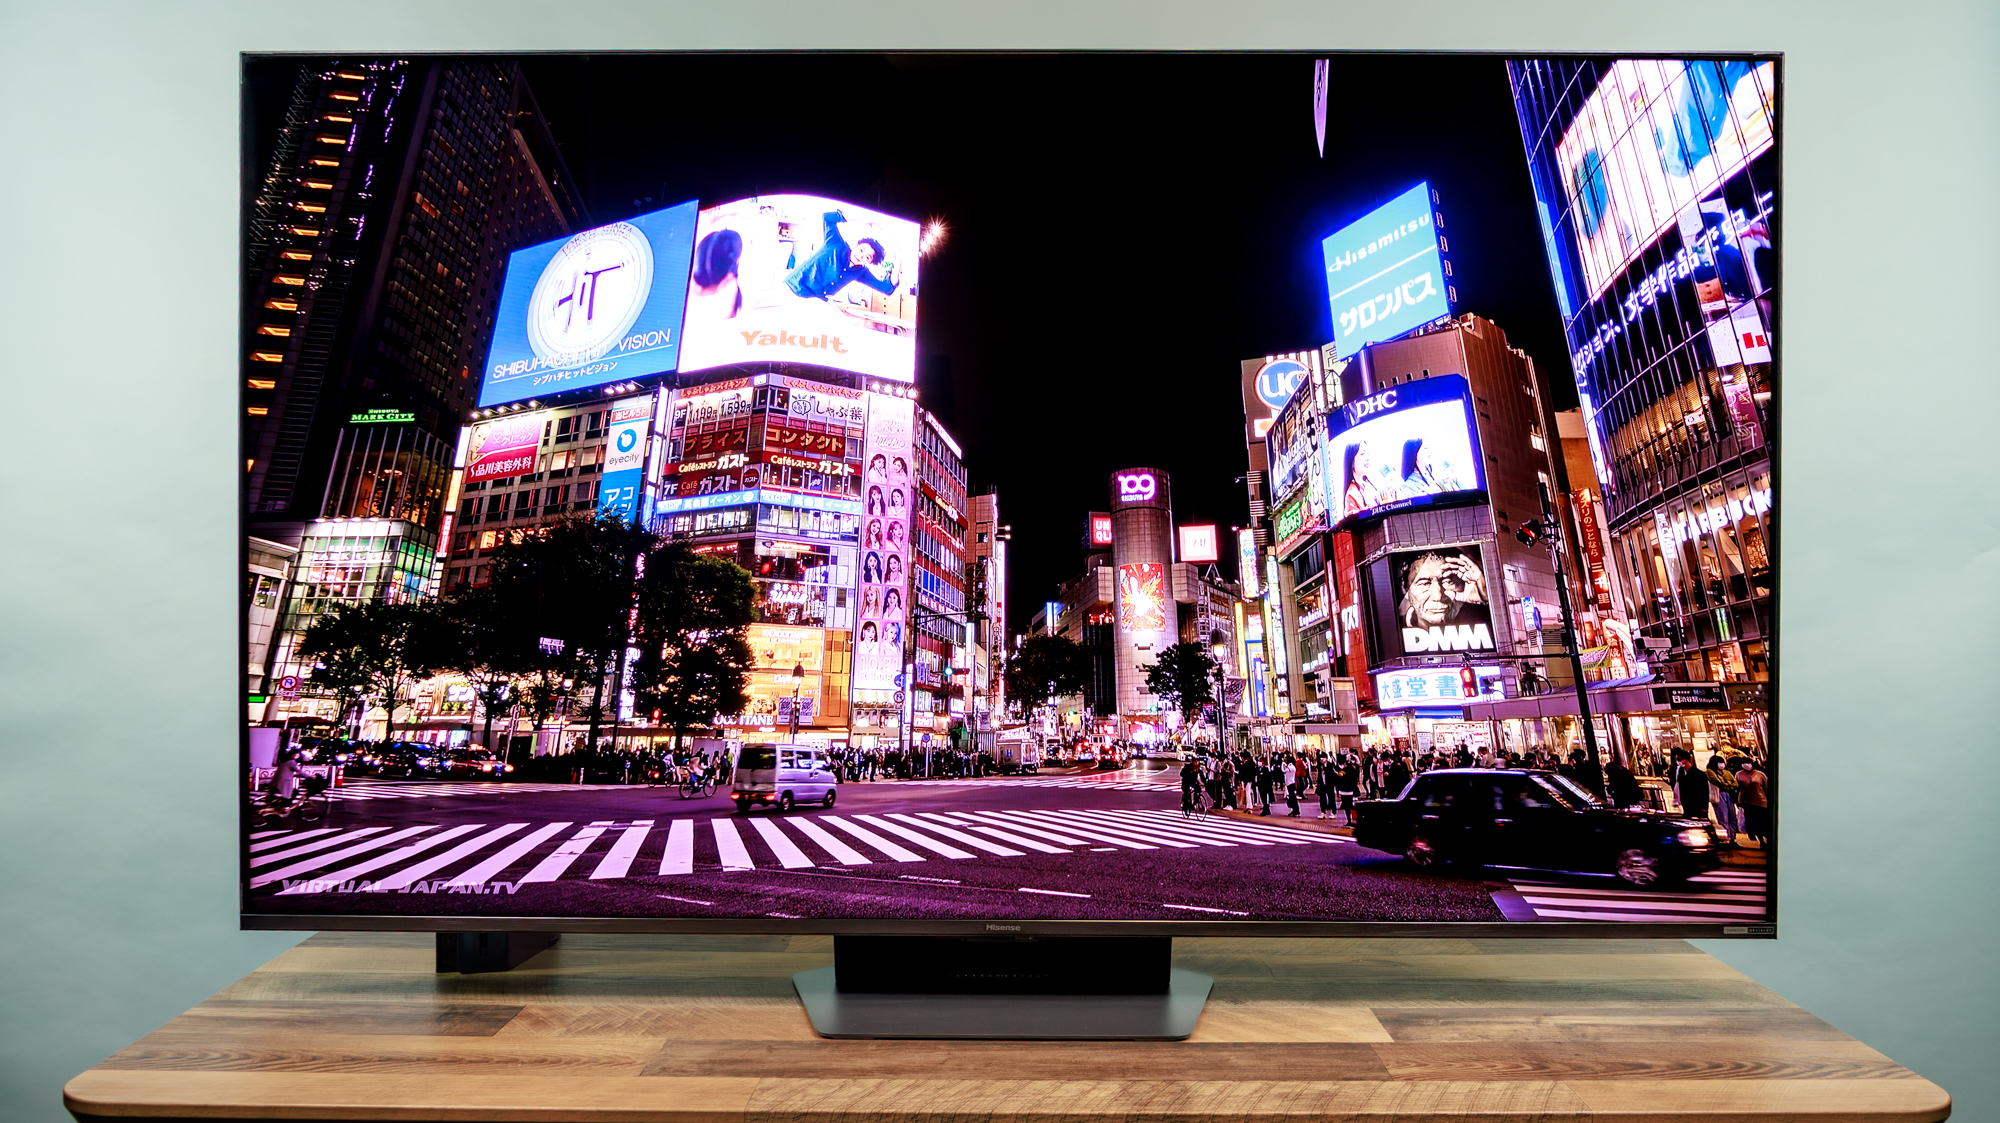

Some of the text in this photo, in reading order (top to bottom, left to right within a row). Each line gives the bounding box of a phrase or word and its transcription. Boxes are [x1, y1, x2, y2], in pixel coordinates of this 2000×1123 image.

[1328, 213, 1430, 272] Hisamitsu
[1340, 271, 1437, 337] サロンパス
[618, 328, 671, 352] VISION
[741, 329, 849, 355] Yakult
[533, 360, 618, 386] シブハチヒットビジョン
[680, 377, 750, 398] しゃぶしゃぶバイキング
[782, 376, 864, 400] しゃぶしゃぶバイキング
[614, 407, 647, 421] 当ビル5F
[674, 408, 686, 420] 9F
[814, 396, 863, 421] しゃぶ葉
[1356, 390, 1398, 418] DHC
[386, 412, 415, 420] CITY
[501, 433, 533, 446] クリニック
[766, 428, 845, 453] コンタクト
[474, 455, 533, 477] 品川美容外科
[609, 452, 639, 466] eyecity
[717, 453, 750, 470] ガスト
[818, 460, 855, 477] ガスト
[664, 484, 678, 495] 7F
[681, 480, 698, 490] Café
[698, 474, 738, 495] ガスト
[1117, 474, 1156, 501] 109
[1386, 499, 1412, 511] Channel
[1676, 488, 1772, 542] TARBUCK
[1095, 520, 1111, 530] UN
[1402, 623, 1494, 653] DMM
[860, 657, 900, 671] 10.21
[860, 671, 896, 682] Releas
[986, 923, 1021, 931] Hisense
